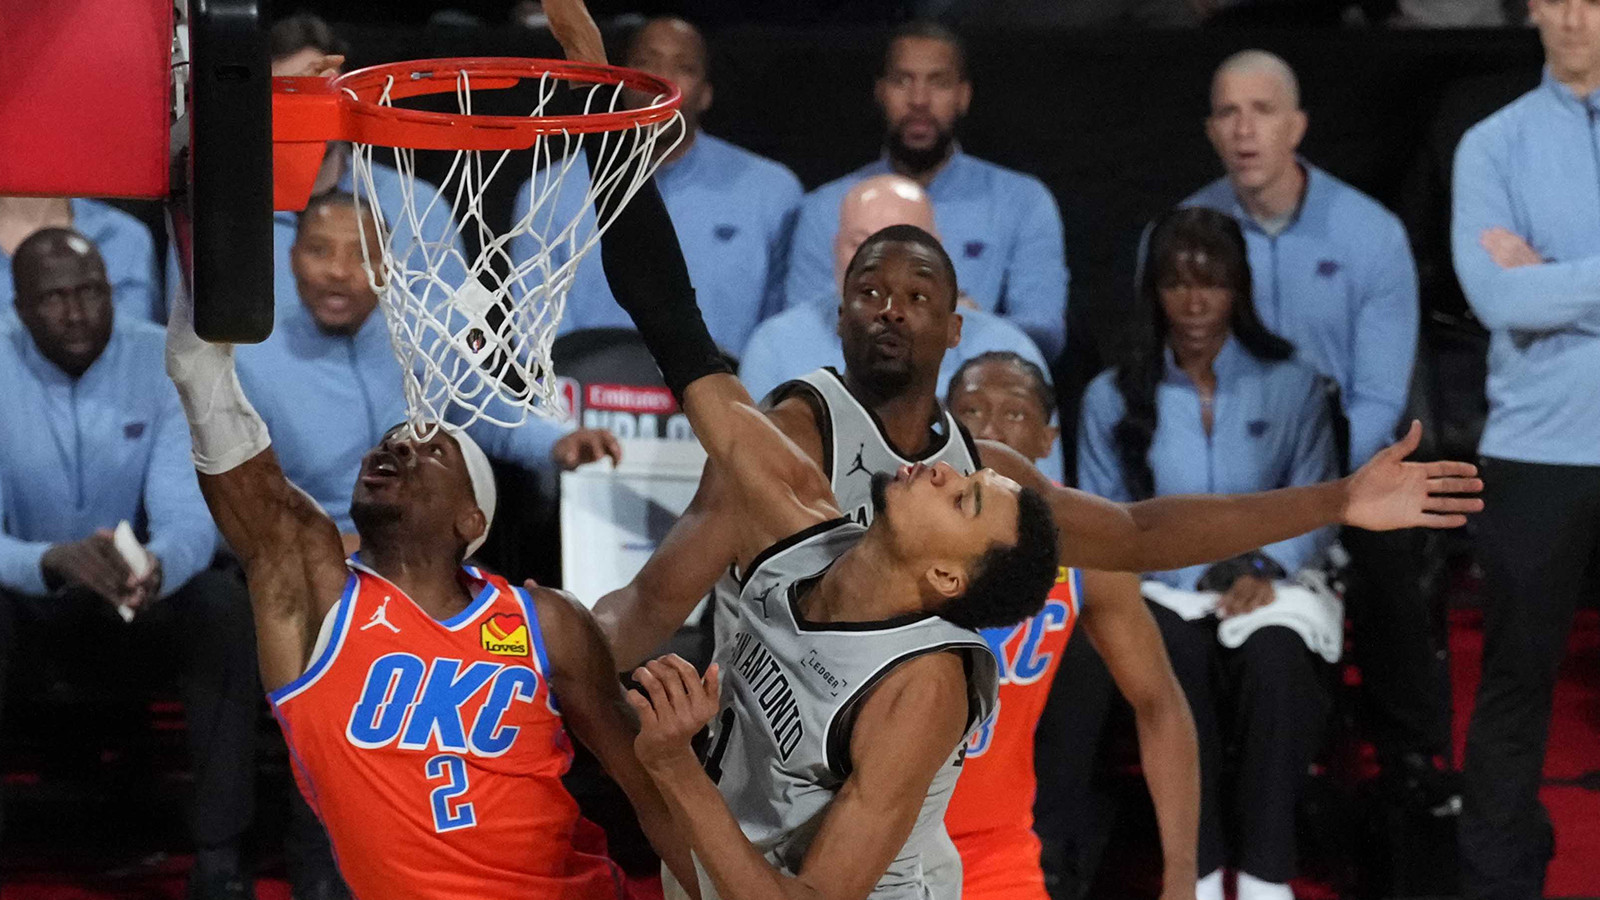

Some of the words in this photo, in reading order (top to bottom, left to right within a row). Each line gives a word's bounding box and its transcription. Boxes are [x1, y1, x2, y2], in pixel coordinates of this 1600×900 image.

[589, 384, 671, 410] Emirates
[808, 657, 839, 689] LEDGER
[976, 599, 1070, 686] KC
[345, 652, 539, 758] OKC
[737, 641, 805, 764] ANTONIO
[425, 754, 477, 833] 2
